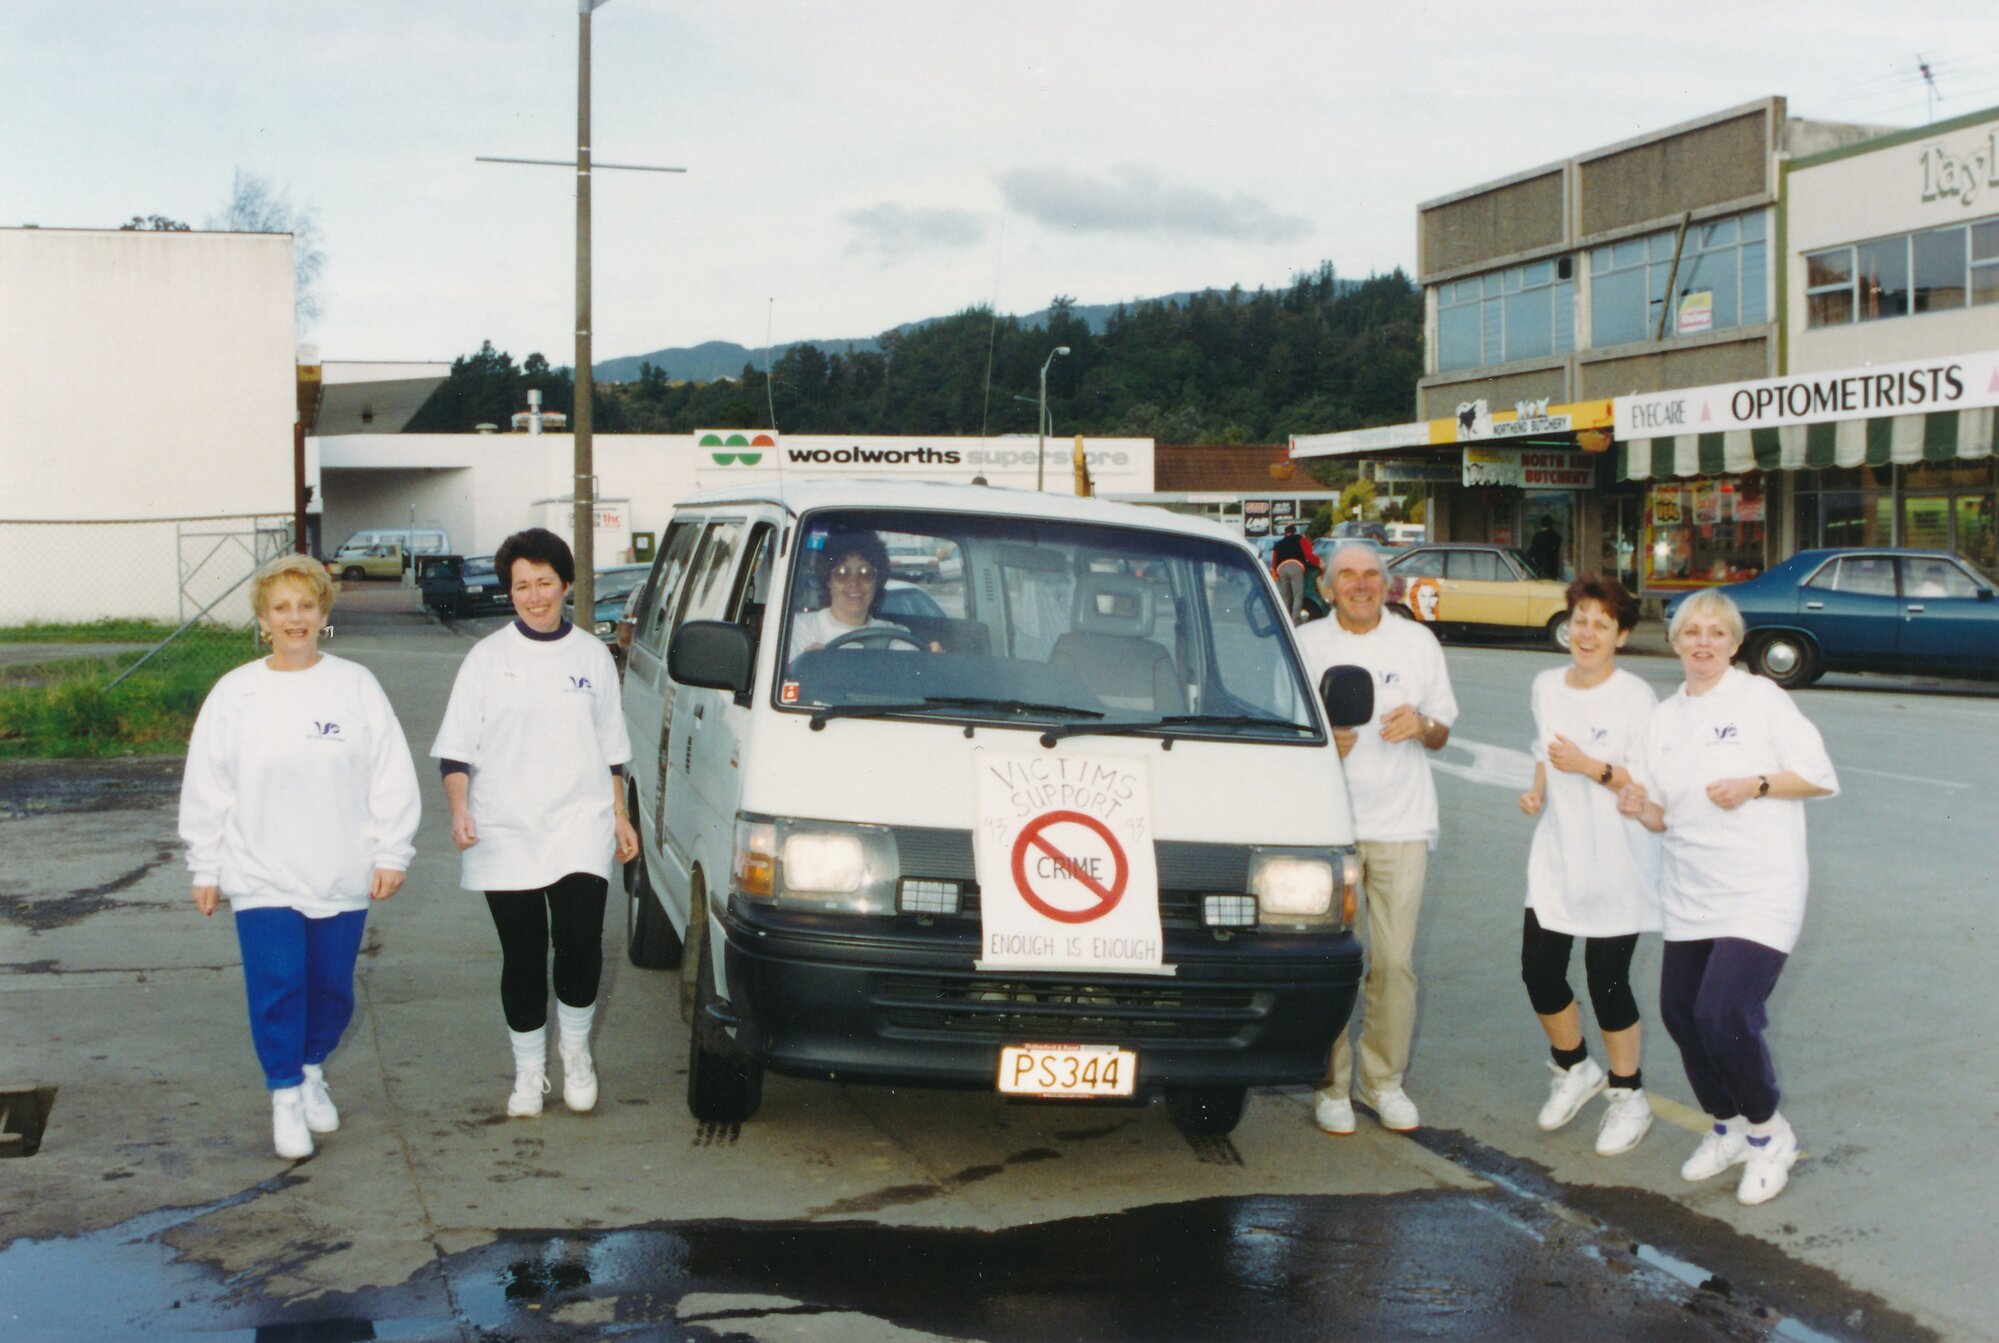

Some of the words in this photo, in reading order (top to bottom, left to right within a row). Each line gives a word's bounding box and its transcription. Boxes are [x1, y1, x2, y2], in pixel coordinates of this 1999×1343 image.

[1731, 364, 1964, 422] OPTOMETRISTS
[1531, 416, 1568, 432] BUTCHERY
[1632, 400, 1686, 429] EYECARE
[788, 446, 961, 464] woolworths
[967, 449, 1129, 466] supersore
[1520, 453, 1564, 468] NORTH
[1524, 469, 1590, 484] BUTCHERY
[990, 757, 1137, 800] VICTIMS
[1010, 784, 1122, 818] SUPPORT
[1036, 856, 1103, 881] CRIME
[991, 934, 1054, 956] ENOUGH
[1067, 937, 1082, 957] IS
[1093, 938, 1156, 961] ENOUGH
[1013, 1053, 1119, 1090] PS344
